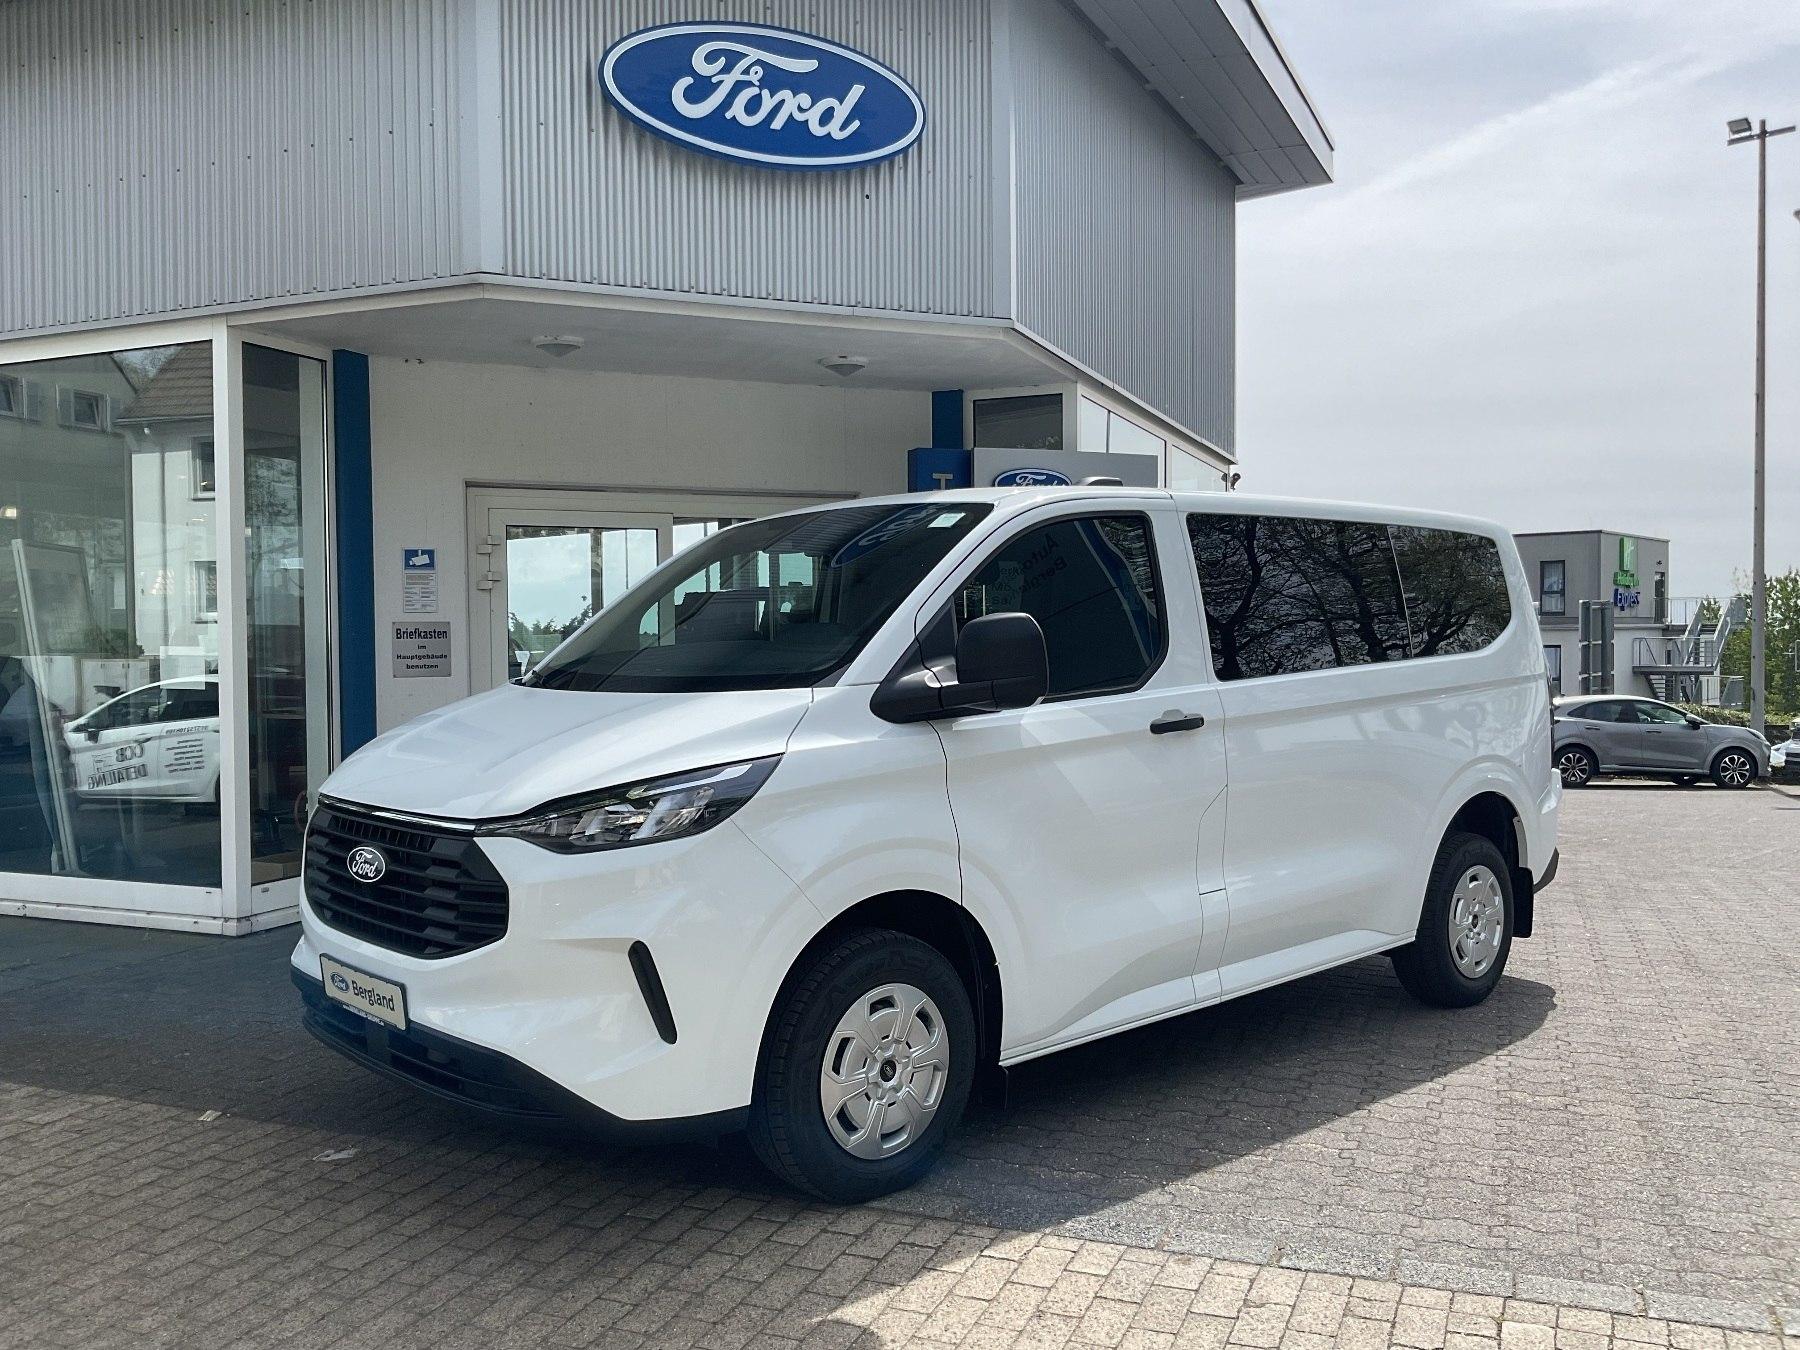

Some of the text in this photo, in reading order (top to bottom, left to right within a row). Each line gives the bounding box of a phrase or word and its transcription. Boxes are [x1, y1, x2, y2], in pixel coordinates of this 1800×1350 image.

[671, 41, 866, 140] Ford
[395, 628, 448, 640] Briefkasten
[417, 643, 427, 651] im
[396, 653, 448, 661] Hauptgebäude
[352, 850, 377, 877] Ford
[352, 980, 395, 1011] Bergland
